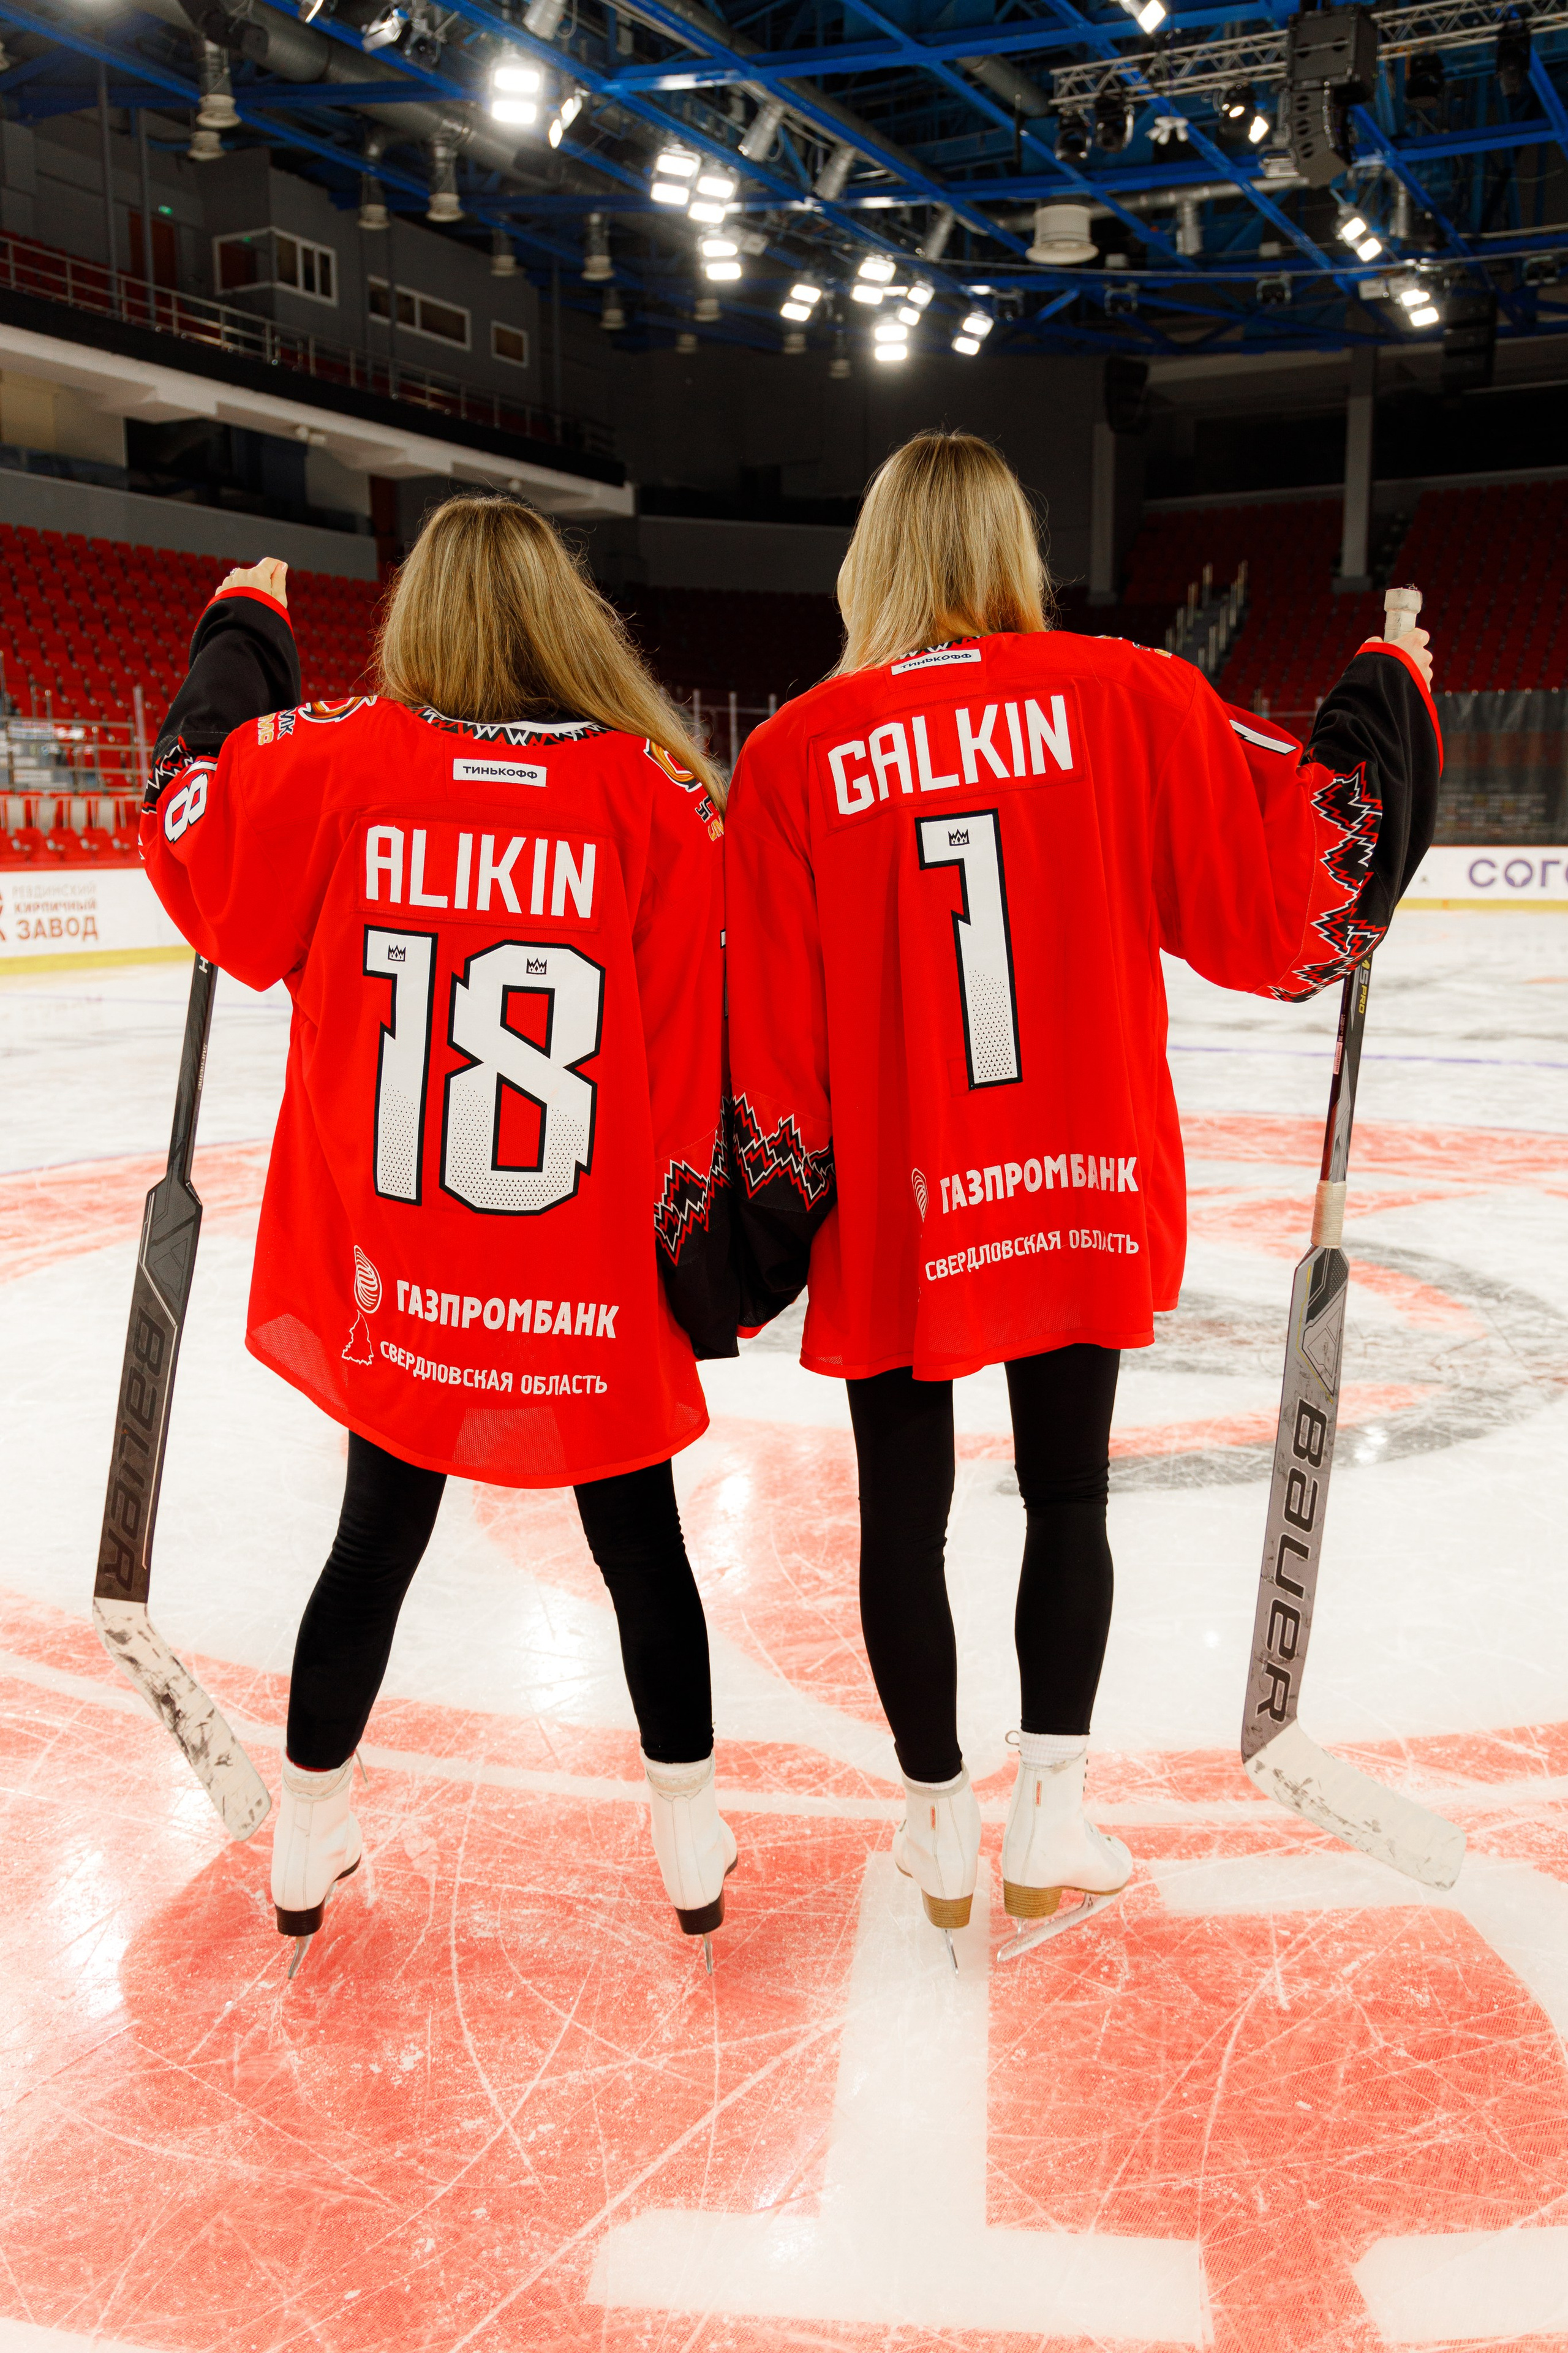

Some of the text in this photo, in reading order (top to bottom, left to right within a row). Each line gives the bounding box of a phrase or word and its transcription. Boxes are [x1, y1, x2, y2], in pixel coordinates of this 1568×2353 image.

[900, 653, 972, 669] ТИНЬКОФФ
[462, 766, 538, 779] ТИНЬКОФФ
[827, 695, 1074, 815] GALKIN
[365, 825, 597, 919] ALIKIN
[1468, 859, 1568, 888] СОГ
[17, 915, 99, 942] ЗАВОД
[914, 807, 1023, 1091] 1
[362, 923, 606, 1217] 18
[939, 1154, 1139, 1214] ГАЗПРОМБАНК
[925, 1230, 1061, 1281] СВЕРДЛОВСКАЯ
[396, 1279, 620, 1339] ГАЗПРОМБАНК
[379, 1340, 608, 1396] СВЕРДЛОВСКАЯ ОБЛАСТЬ
